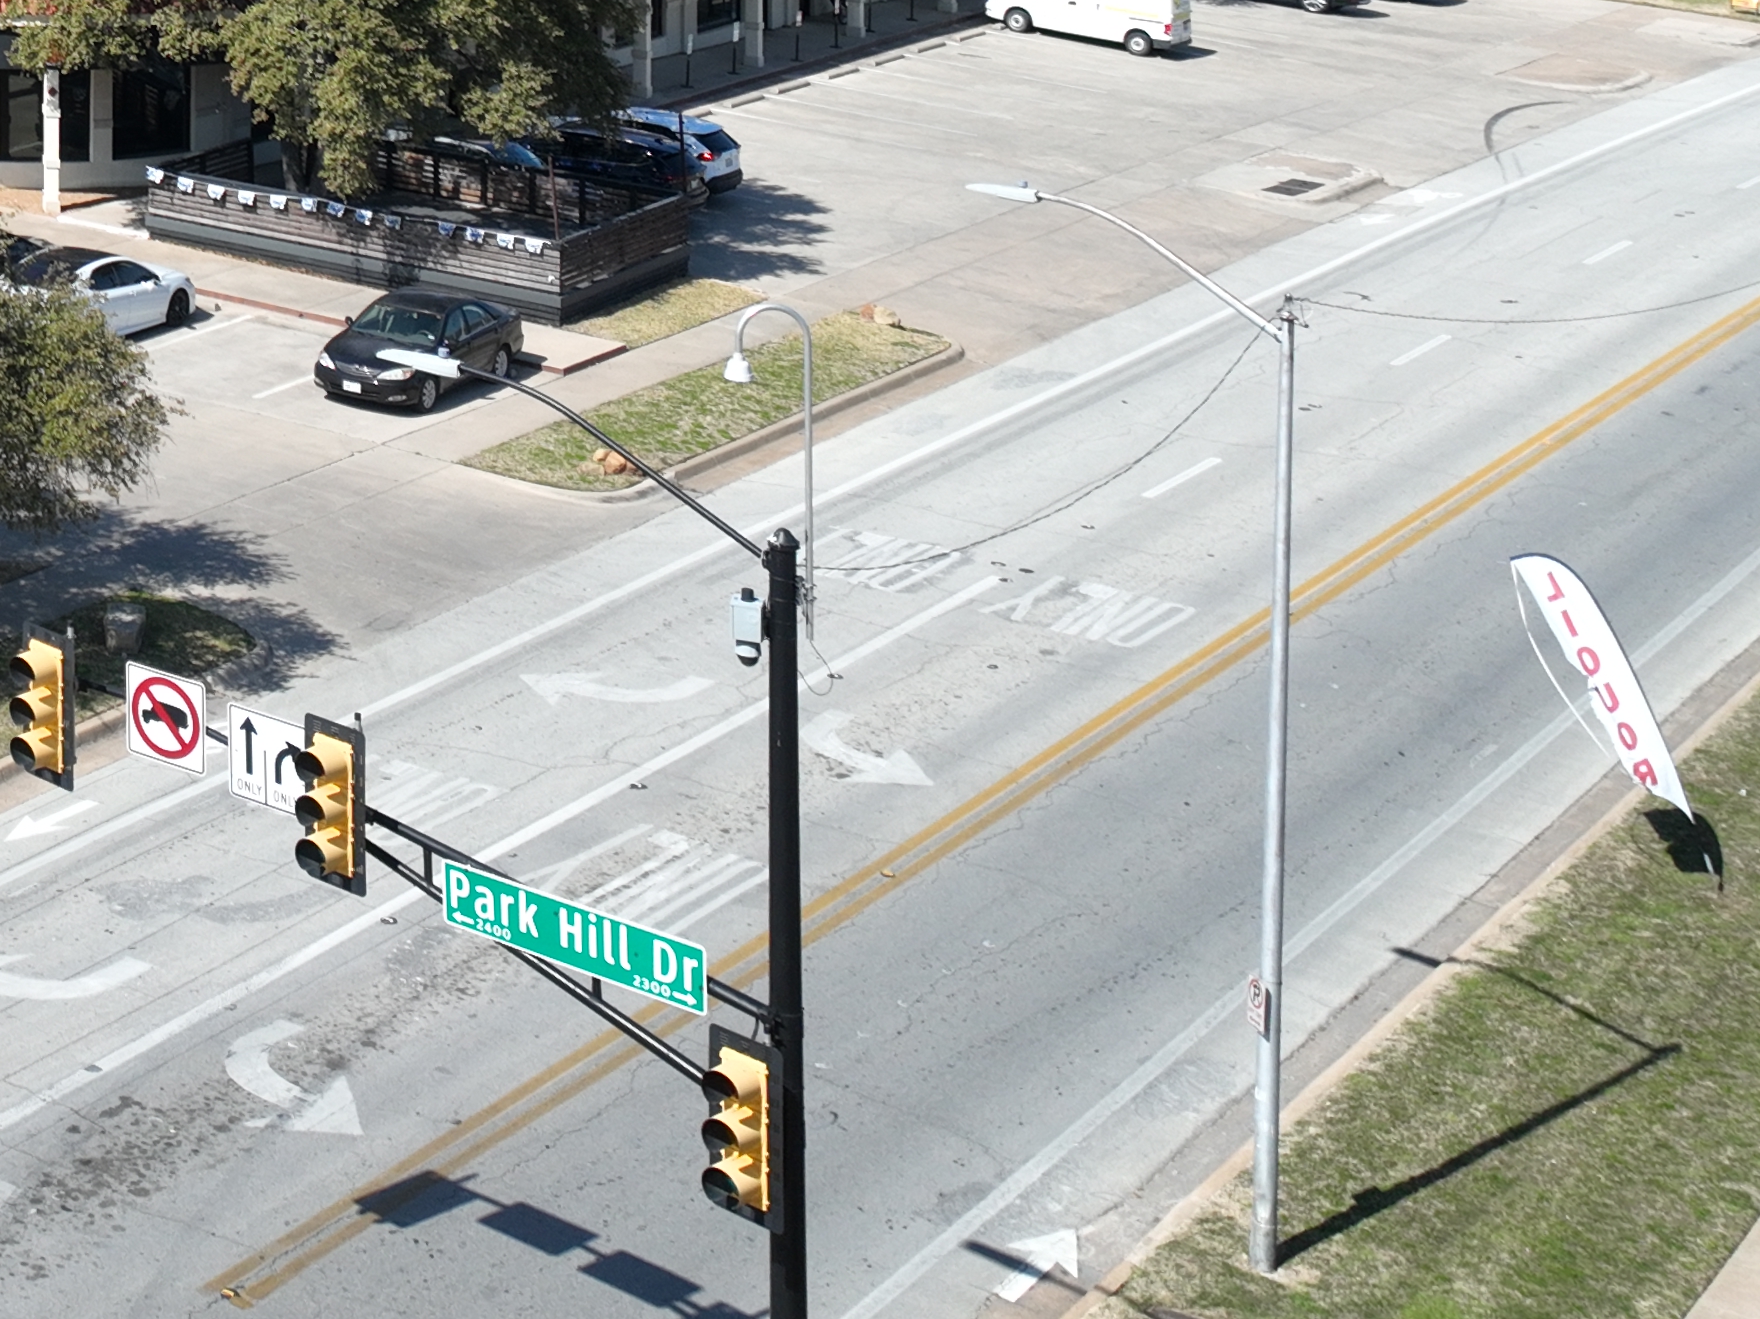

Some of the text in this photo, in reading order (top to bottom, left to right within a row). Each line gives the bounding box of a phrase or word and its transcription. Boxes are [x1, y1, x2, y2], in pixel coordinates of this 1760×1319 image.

[236, 777, 263, 797] ONLY
[450, 868, 699, 992] Park Hill Dr
[475, 918, 512, 941] 2400
[632, 974, 672, 998] 2300
